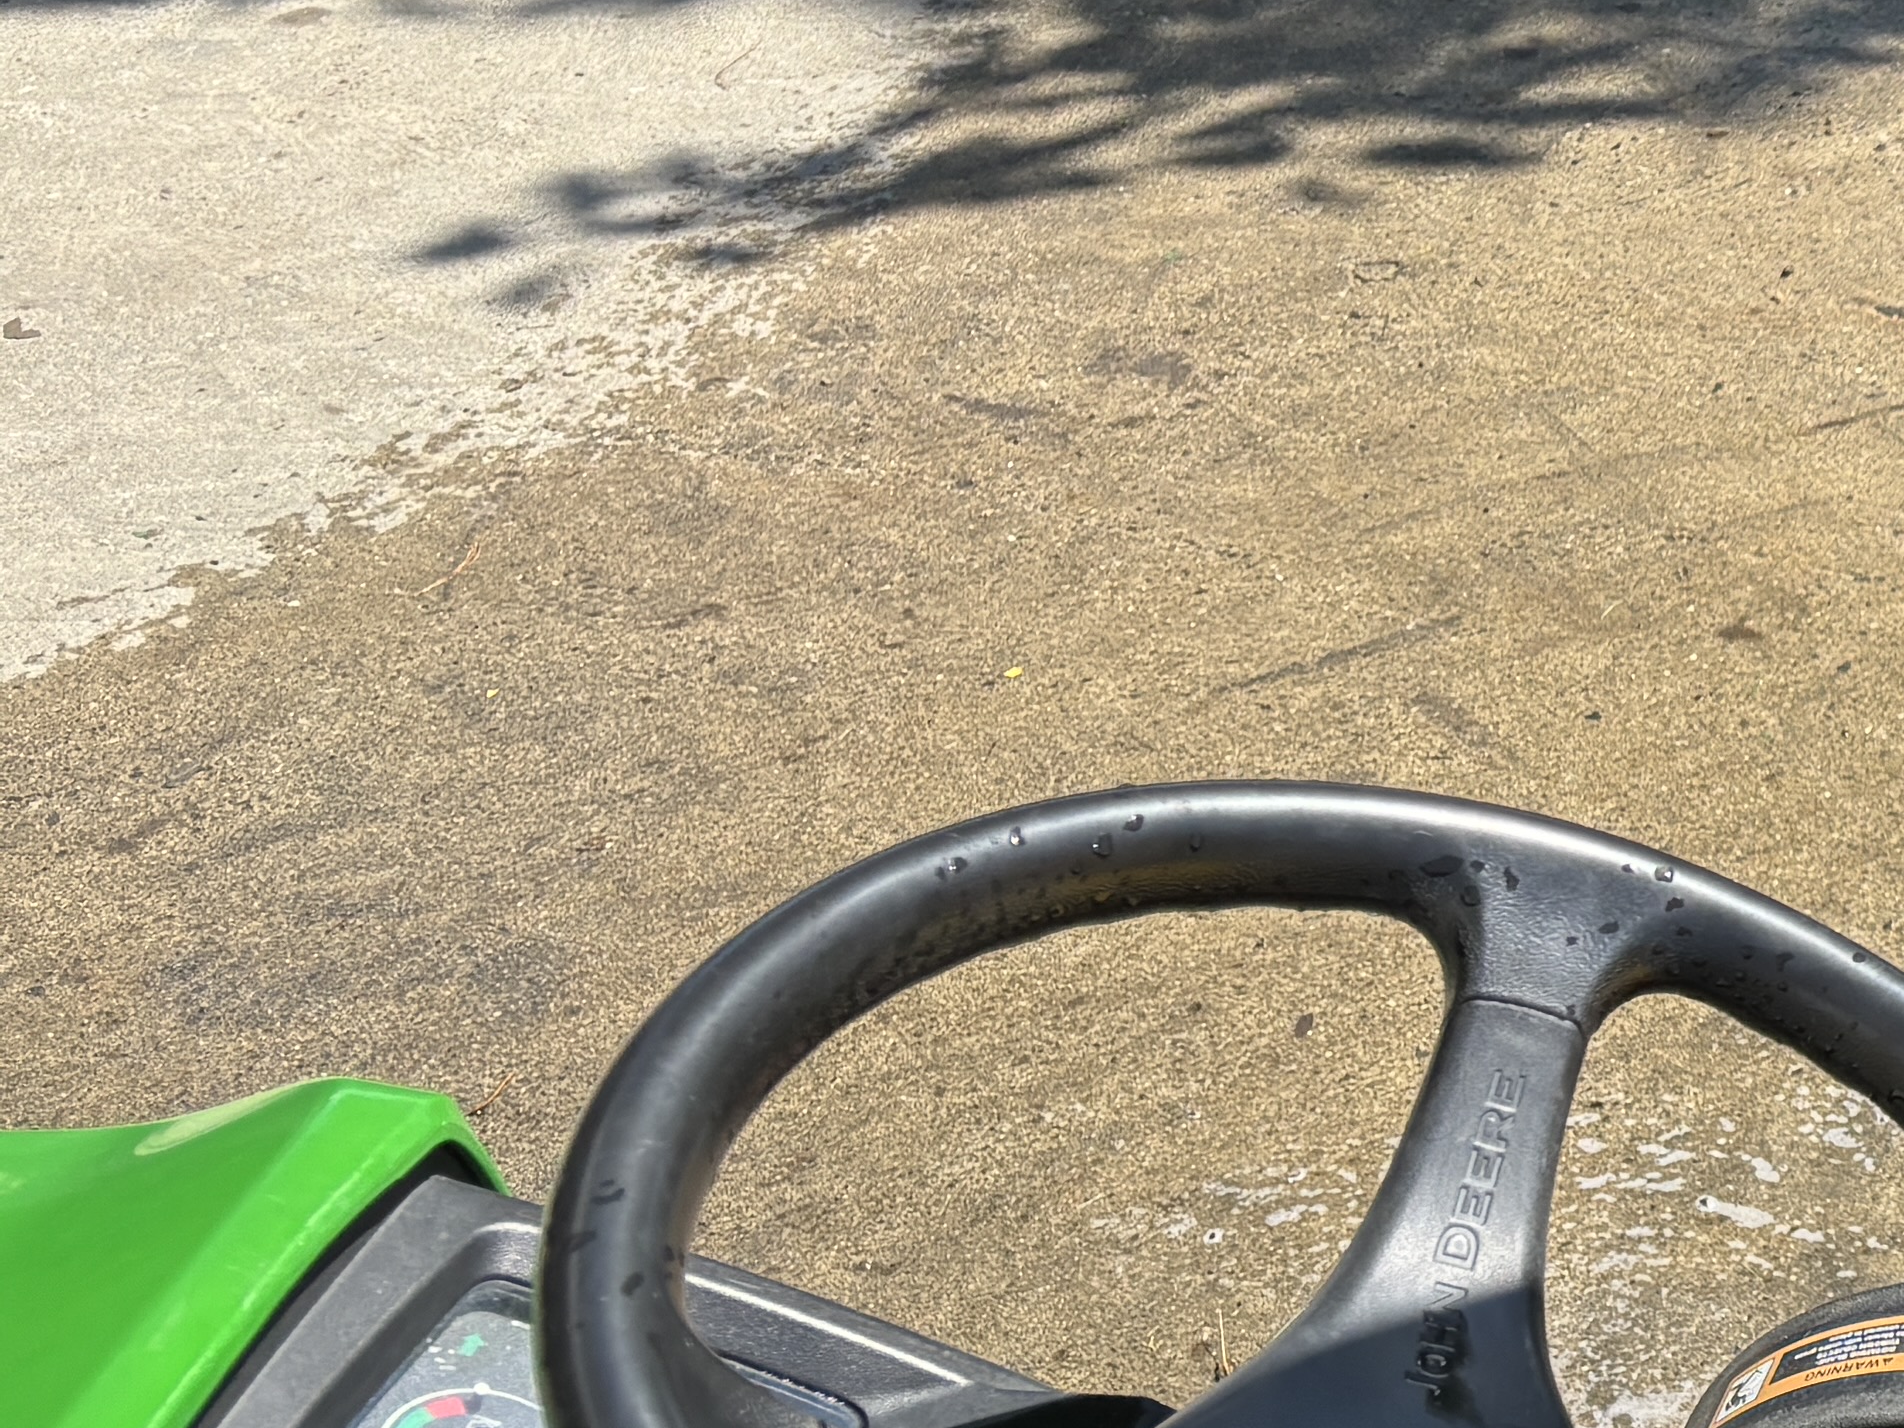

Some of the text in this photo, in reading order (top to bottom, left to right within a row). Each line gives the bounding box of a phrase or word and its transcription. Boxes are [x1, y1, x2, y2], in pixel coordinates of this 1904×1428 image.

[1404, 1069, 1526, 1398] JOHN DEERE
[1804, 1358, 1879, 1382] WARNING
